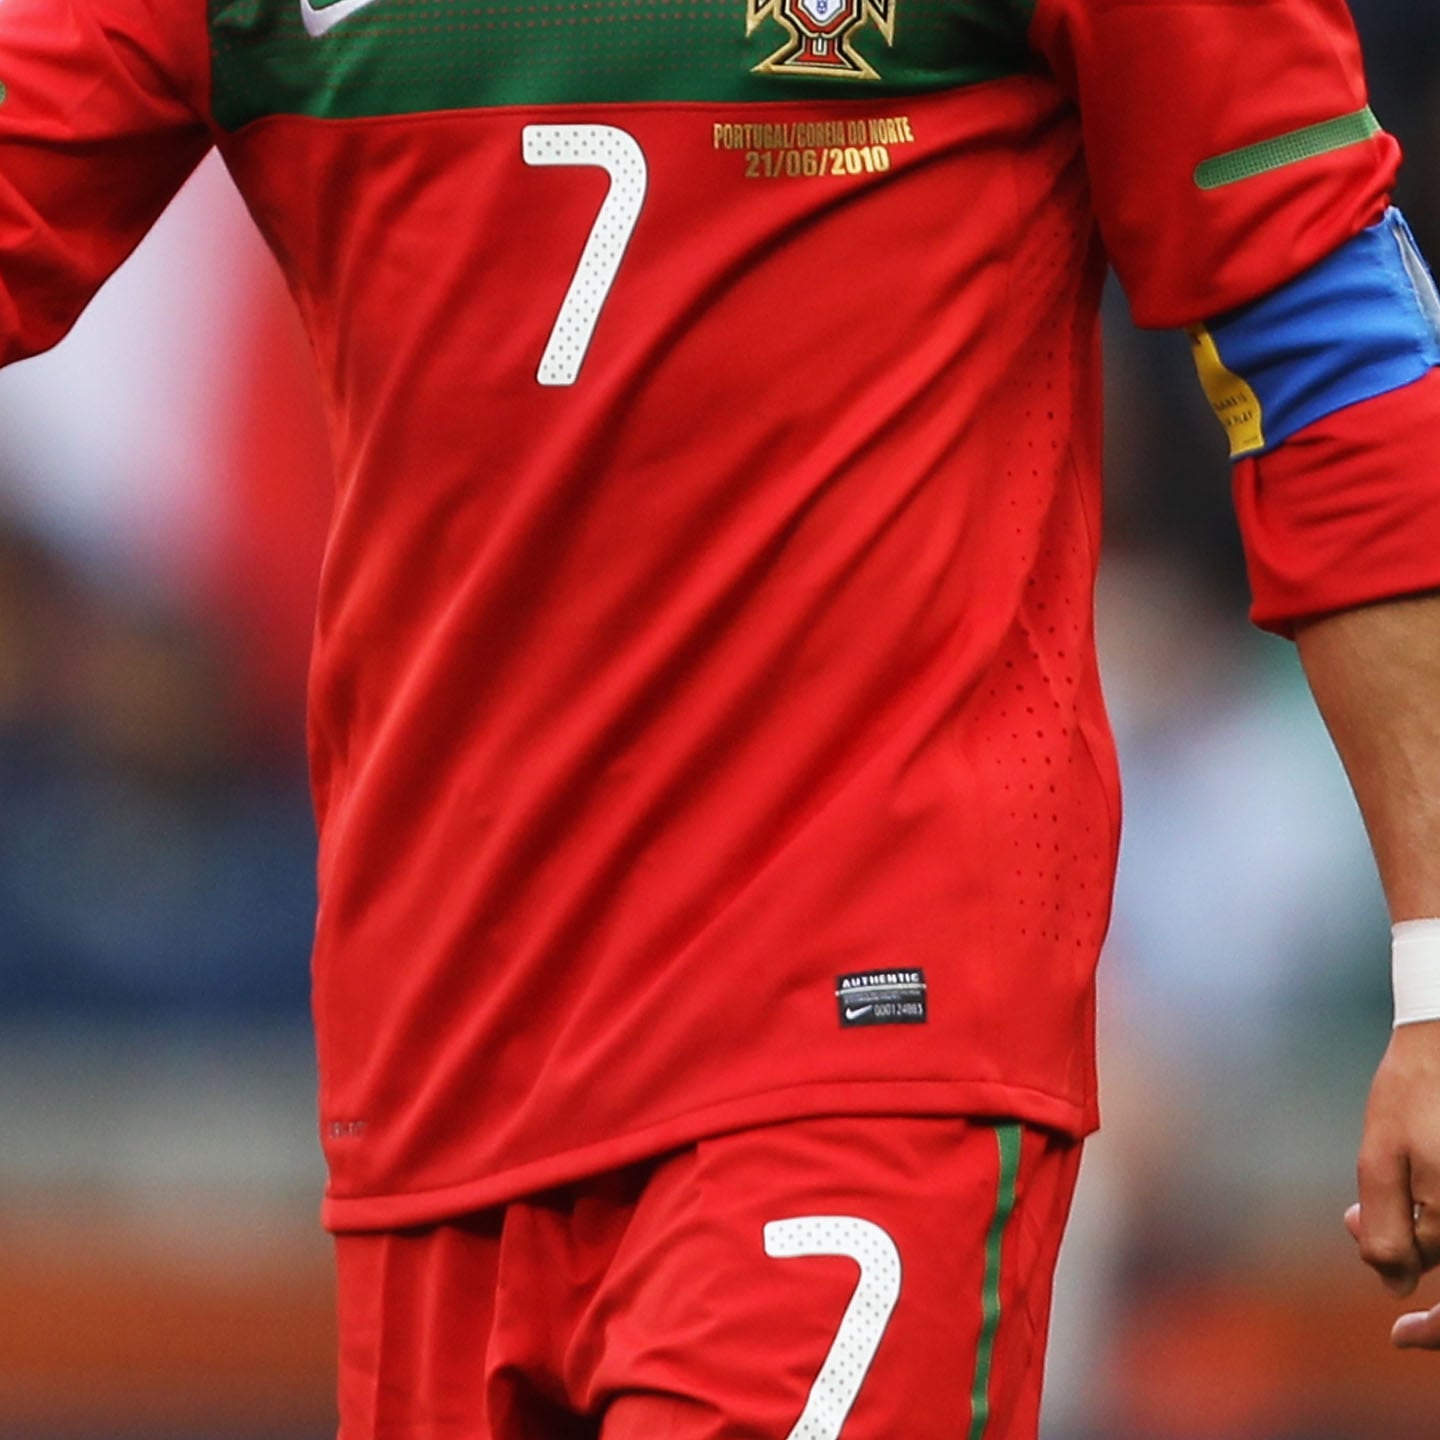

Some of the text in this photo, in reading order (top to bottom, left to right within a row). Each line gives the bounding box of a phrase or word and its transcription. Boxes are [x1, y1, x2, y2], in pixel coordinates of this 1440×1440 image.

[713, 116, 914, 150] PORTUGAL/COREIA DO NORTE
[745, 145, 890, 178] 21/06/2010
[522, 124, 648, 386] 7
[842, 972, 920, 989] AUTHENTIC
[763, 1215, 902, 1440] 7
